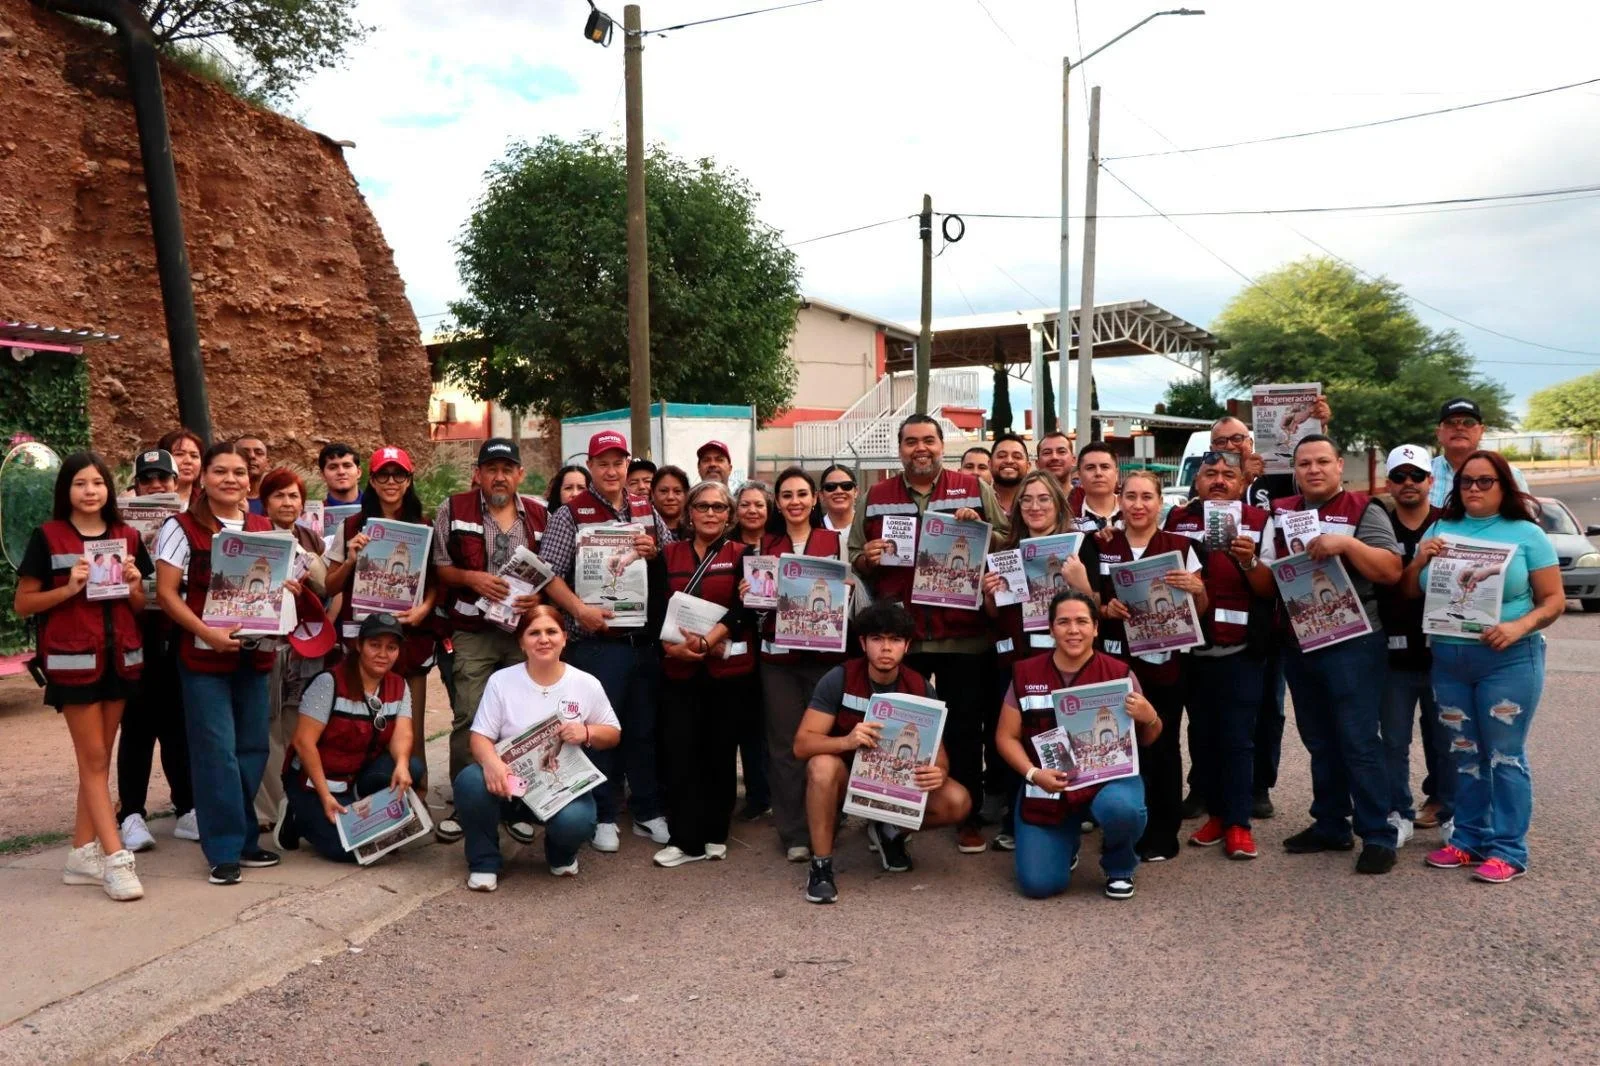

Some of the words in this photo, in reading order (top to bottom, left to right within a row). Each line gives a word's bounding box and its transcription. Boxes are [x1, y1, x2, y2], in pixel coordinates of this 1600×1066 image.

[1264, 394, 1316, 404] Regeneración
[929, 519, 941, 534] la
[1286, 515, 1314, 525] LORENIA
[1288, 520, 1313, 529] VALLES
[370, 526, 383, 539] la
[226, 539, 240, 554] la
[1025, 546, 1035, 559] la
[991, 554, 1018, 564] LORENIA
[1447, 549, 1505, 560] Regeneración
[786, 563, 798, 577] la
[1433, 562, 1450, 570] PLAN
[1119, 571, 1130, 584] la
[1281, 567, 1294, 581] la
[567, 704, 579, 713] 100
[876, 702, 888, 718] la
[1064, 699, 1077, 713] la
[510, 722, 560, 757] Regeneración
